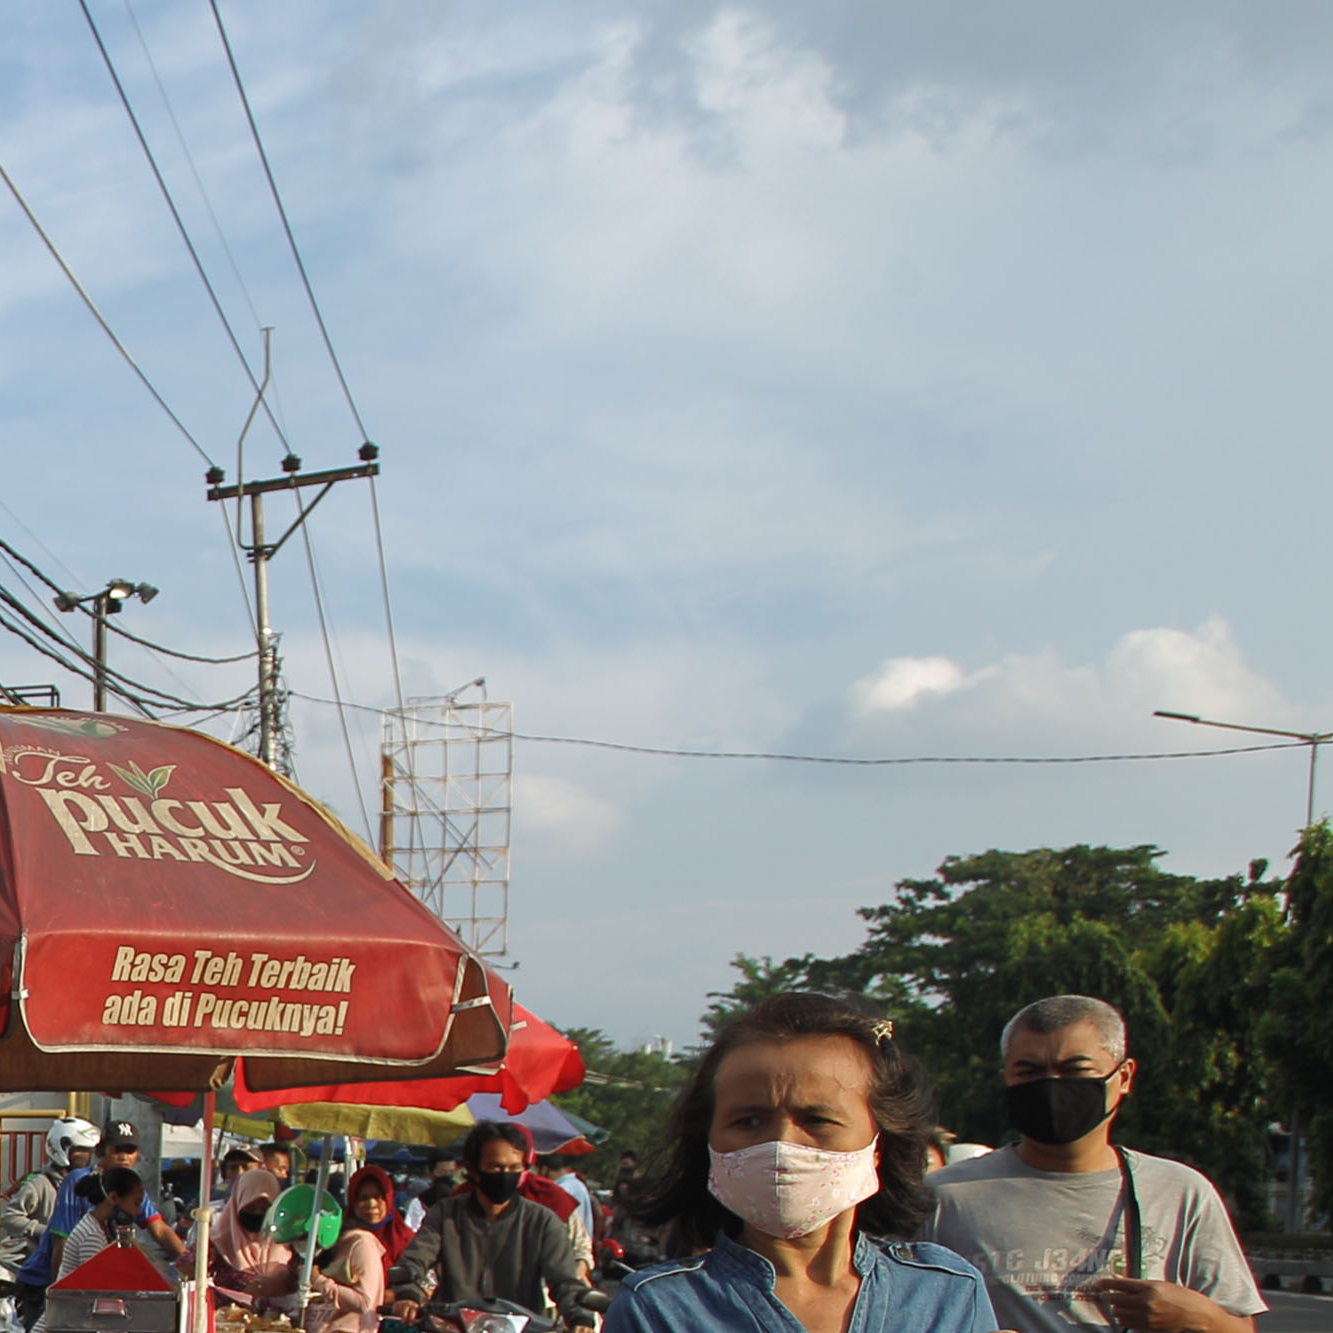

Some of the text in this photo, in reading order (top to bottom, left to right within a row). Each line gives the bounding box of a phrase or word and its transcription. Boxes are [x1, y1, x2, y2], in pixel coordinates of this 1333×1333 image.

[11, 751, 111, 790] Teh
[104, 832, 316, 882] HARUM
[110, 946, 356, 993] Rasa Teh Terbaik
[102, 990, 349, 1037] ada di Pucuknya!
